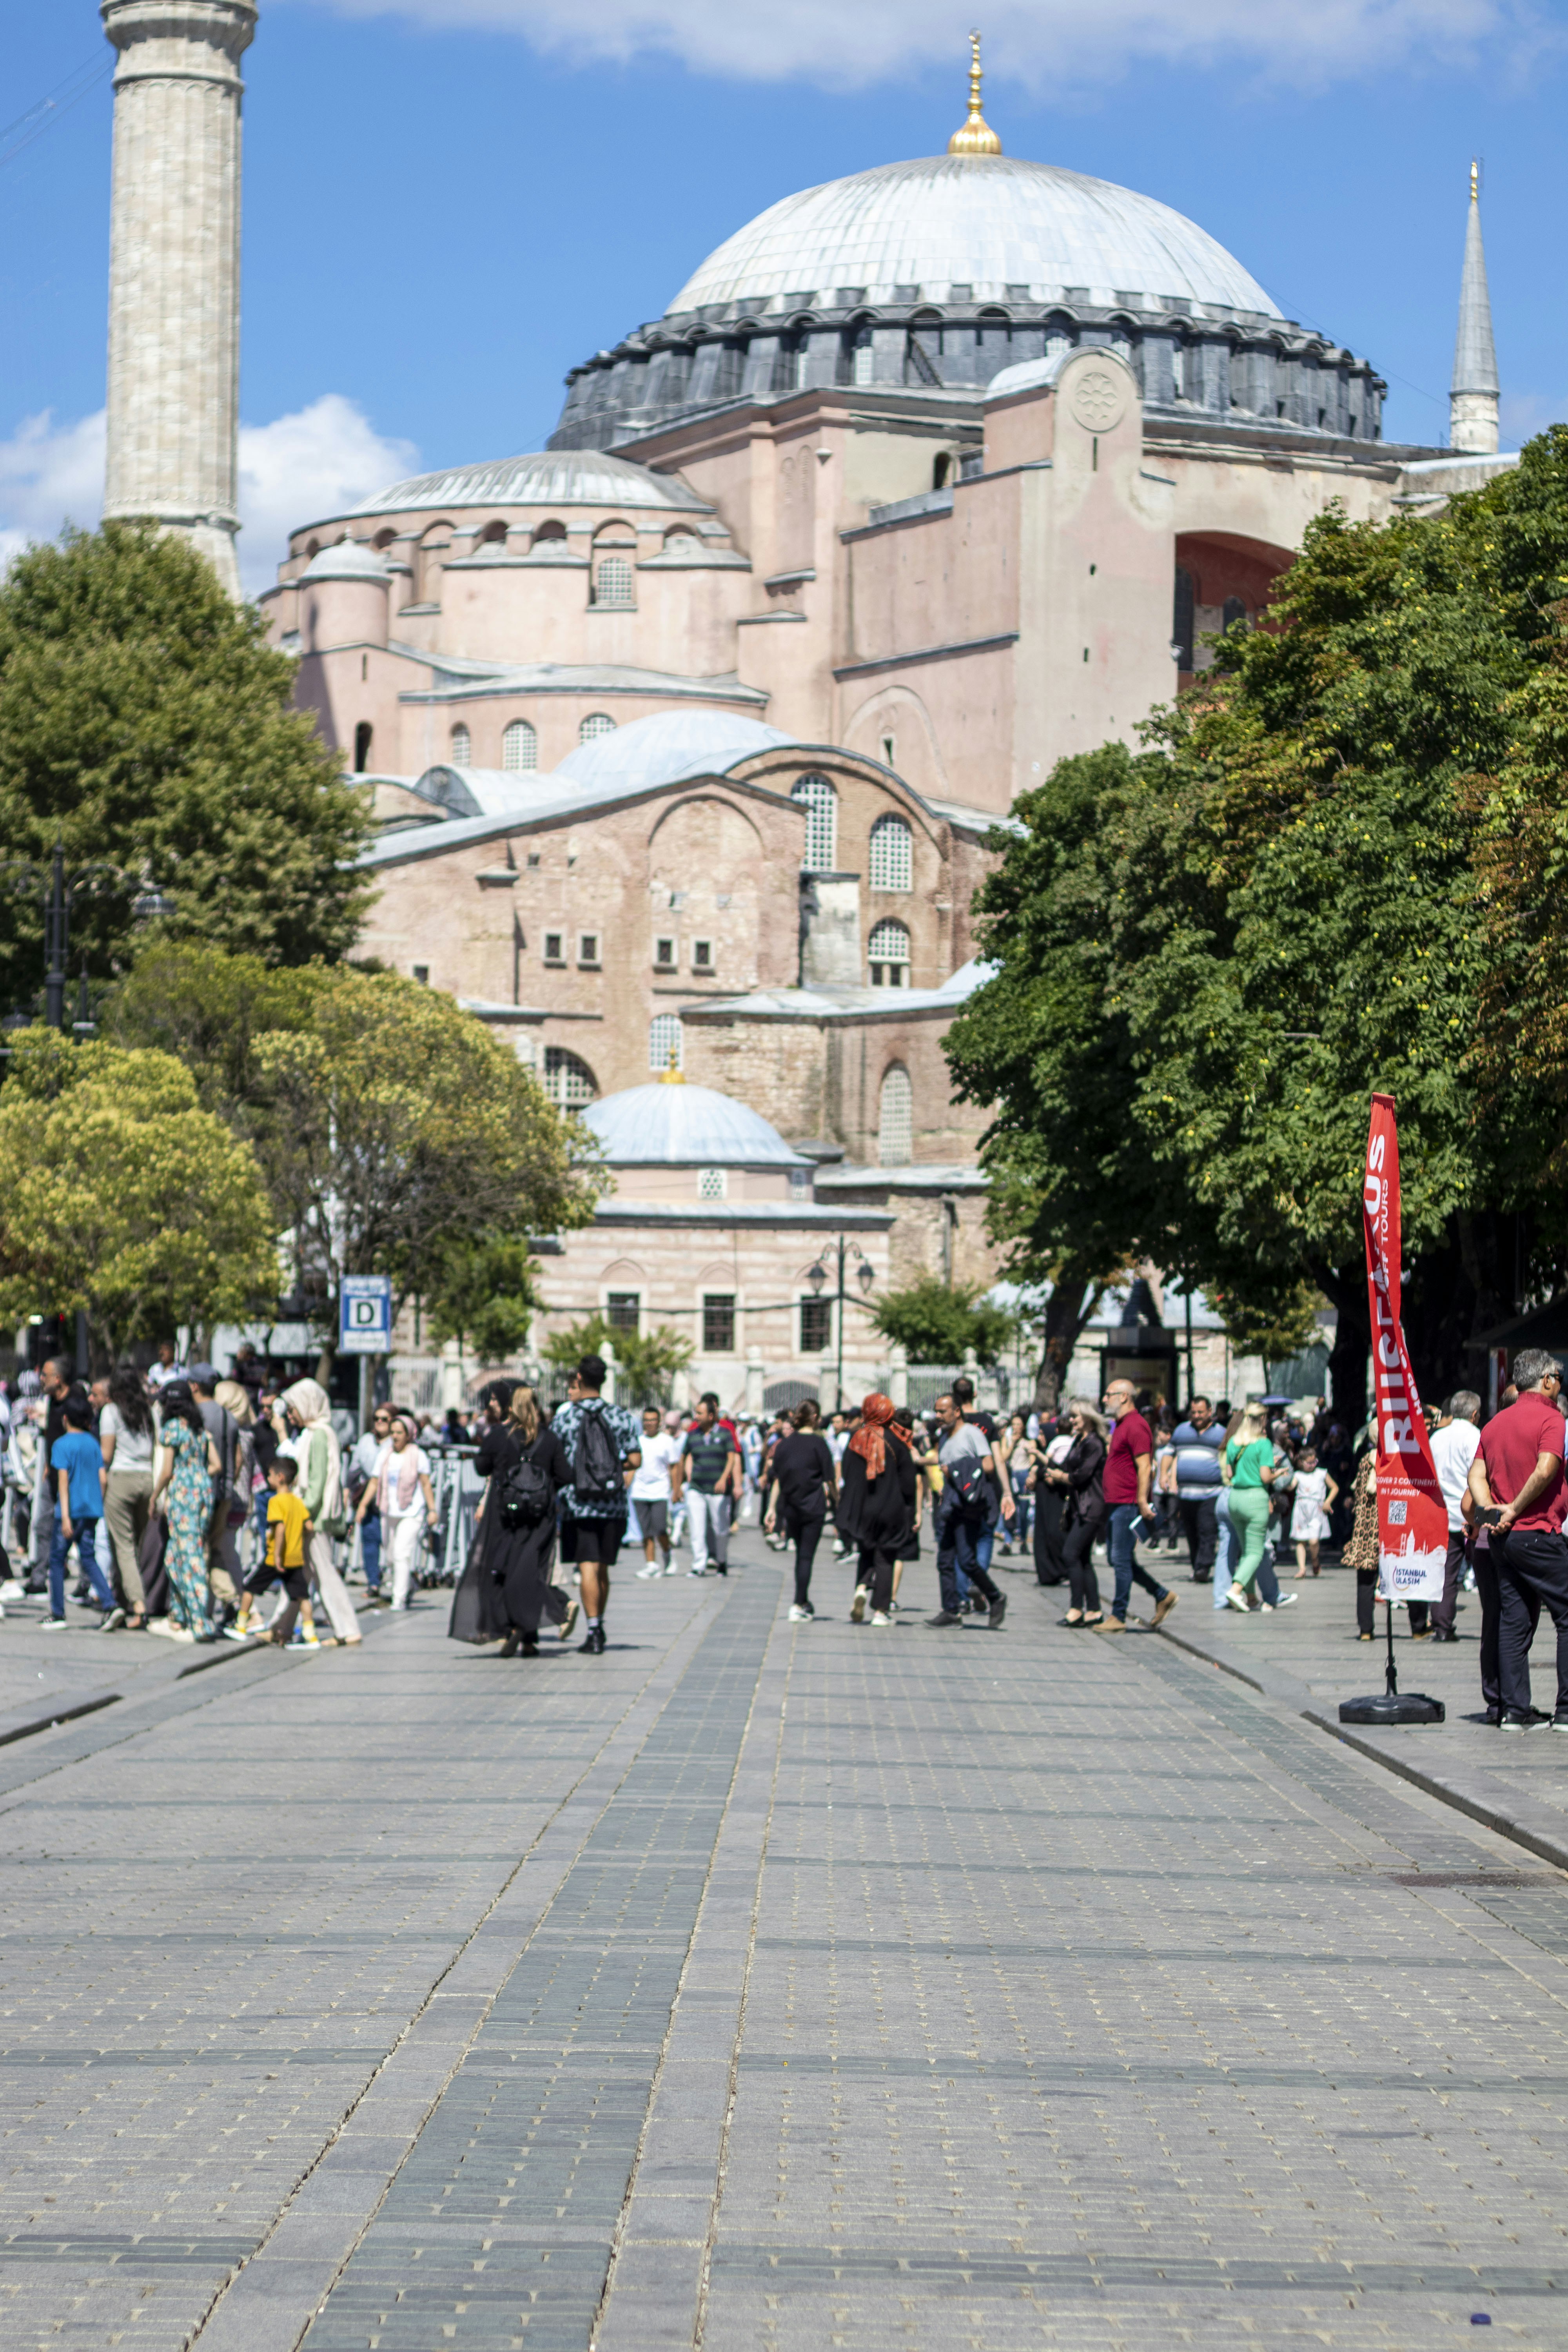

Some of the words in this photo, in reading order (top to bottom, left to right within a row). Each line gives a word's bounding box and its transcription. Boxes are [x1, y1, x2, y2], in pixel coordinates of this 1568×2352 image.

[1364, 1134, 1421, 1454] BUSFUS
[357, 1302, 374, 1324] D
[1390, 1488, 1421, 1497] JOURNEY
